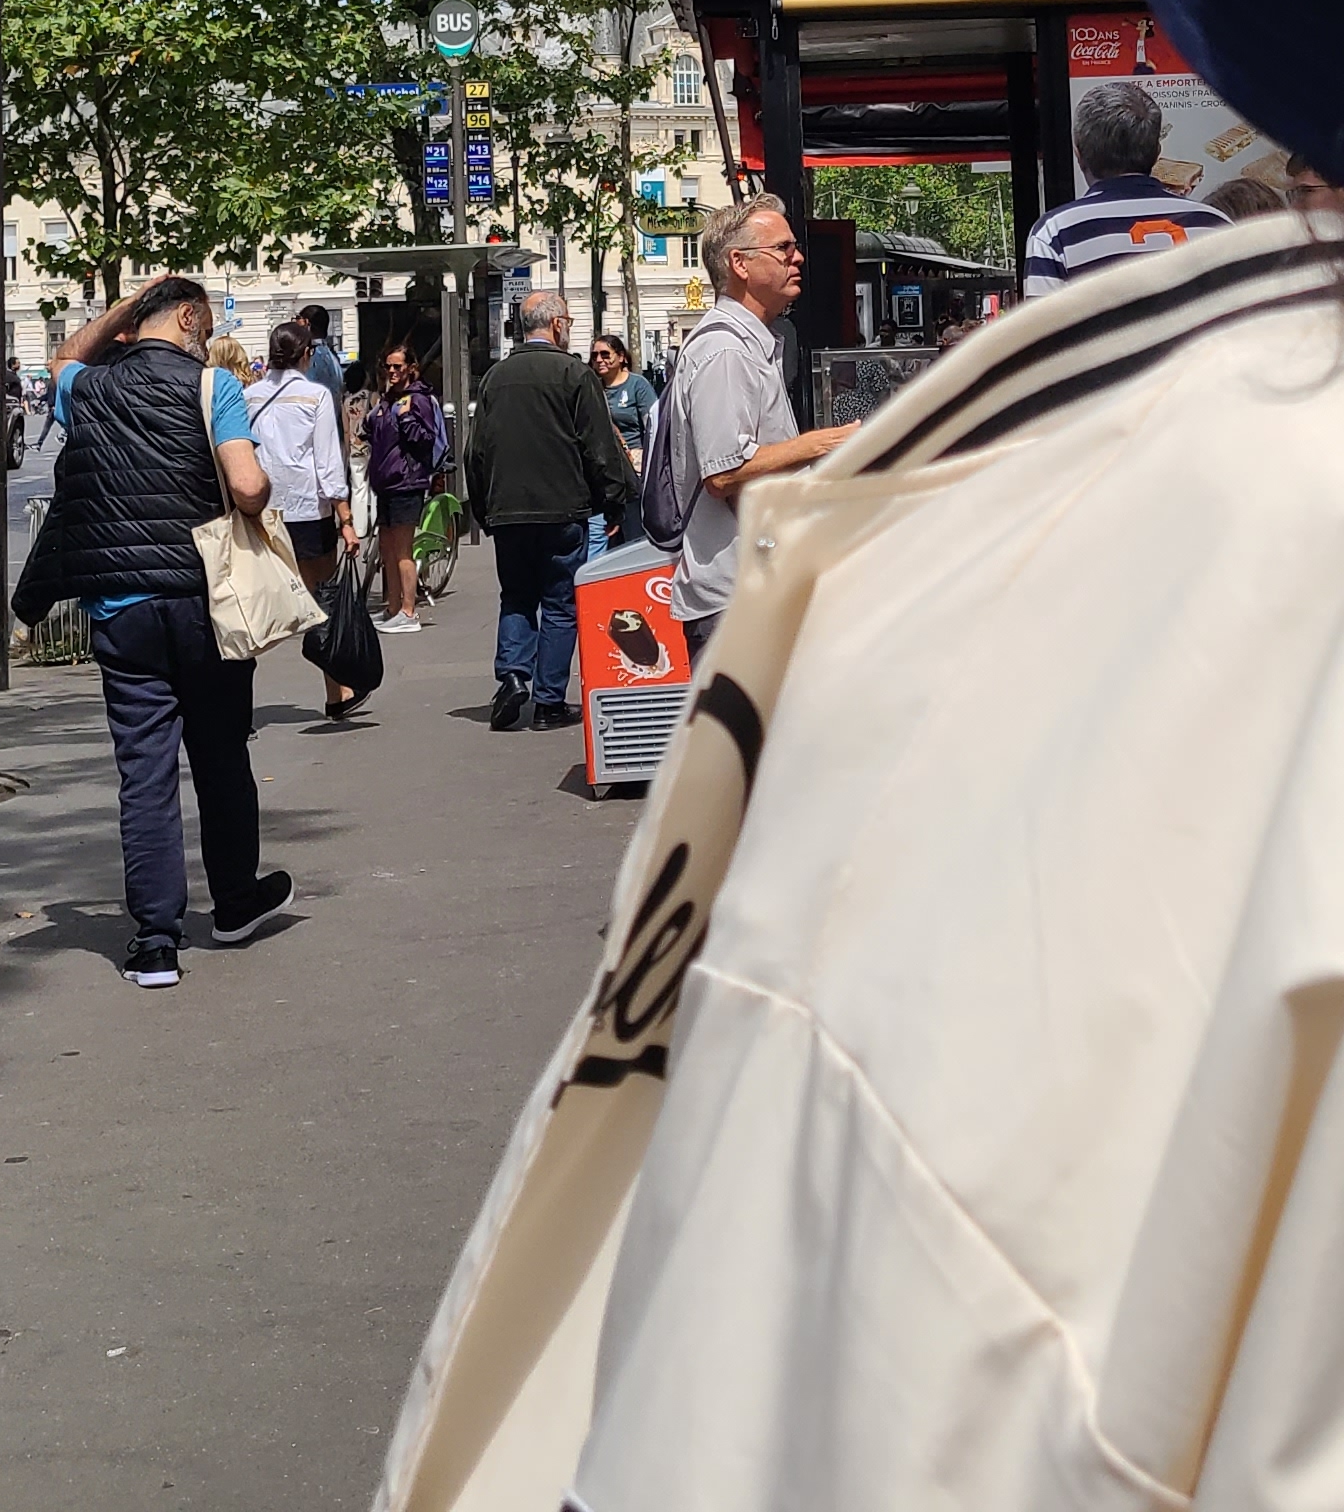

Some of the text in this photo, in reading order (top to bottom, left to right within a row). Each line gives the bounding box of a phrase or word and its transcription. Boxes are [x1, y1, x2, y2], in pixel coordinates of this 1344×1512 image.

[436, 13, 472, 32] BUS
[1097, 31, 1120, 40] ANS
[469, 84, 486, 96] 27
[1200, 100, 1226, 108] CROQ
[470, 114, 487, 127] 96
